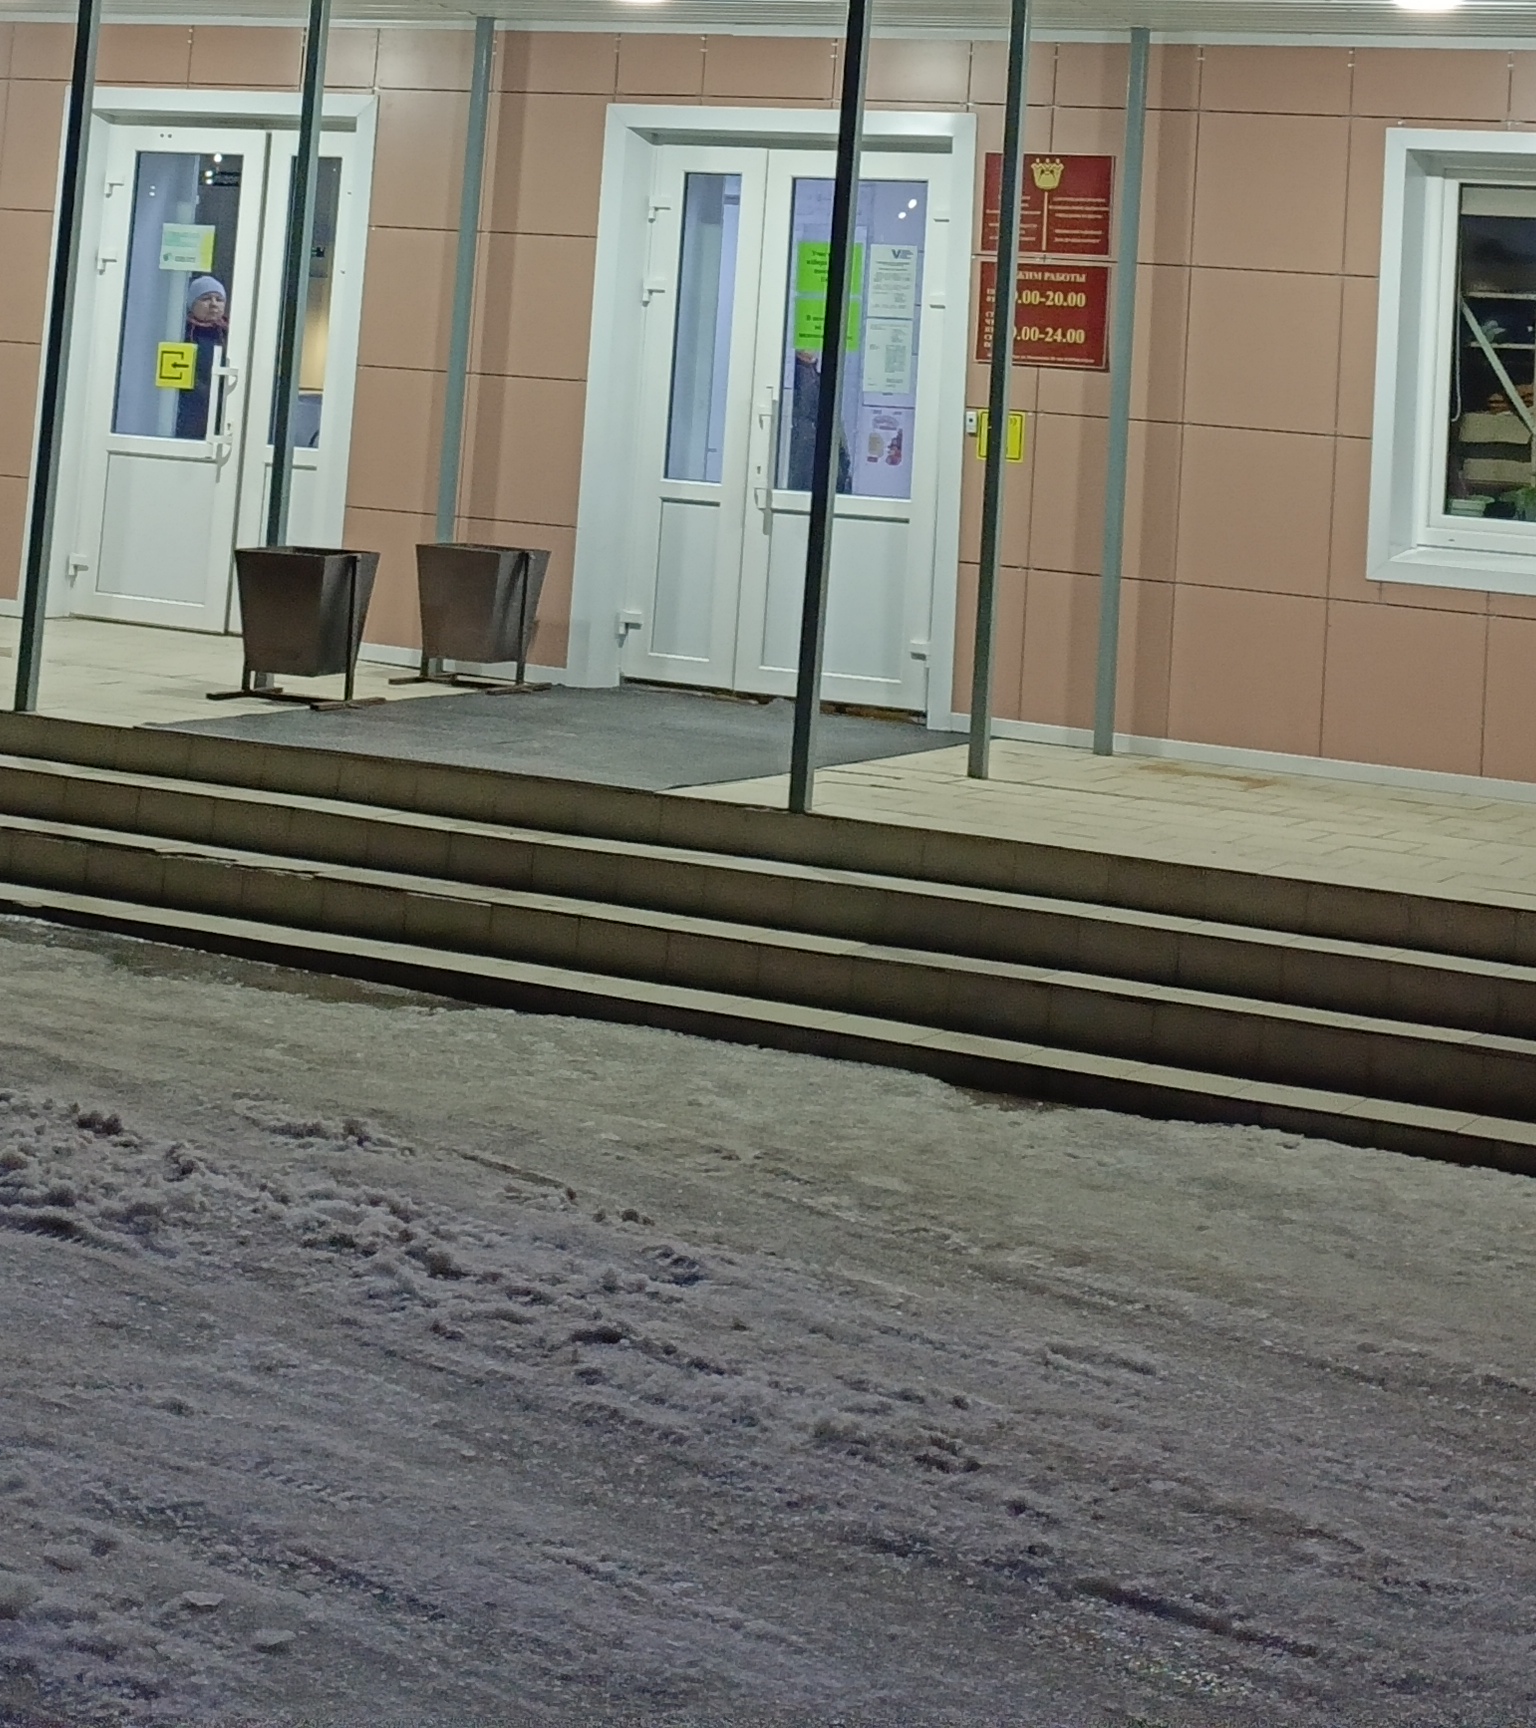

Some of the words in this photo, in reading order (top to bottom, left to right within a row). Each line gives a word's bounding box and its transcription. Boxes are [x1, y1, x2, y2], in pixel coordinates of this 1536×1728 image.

[1044, 271, 1087, 283] РАБОТЫ
[1015, 289, 1086, 307] .00-20.00
[1013, 326, 1086, 344] .00-24.00
